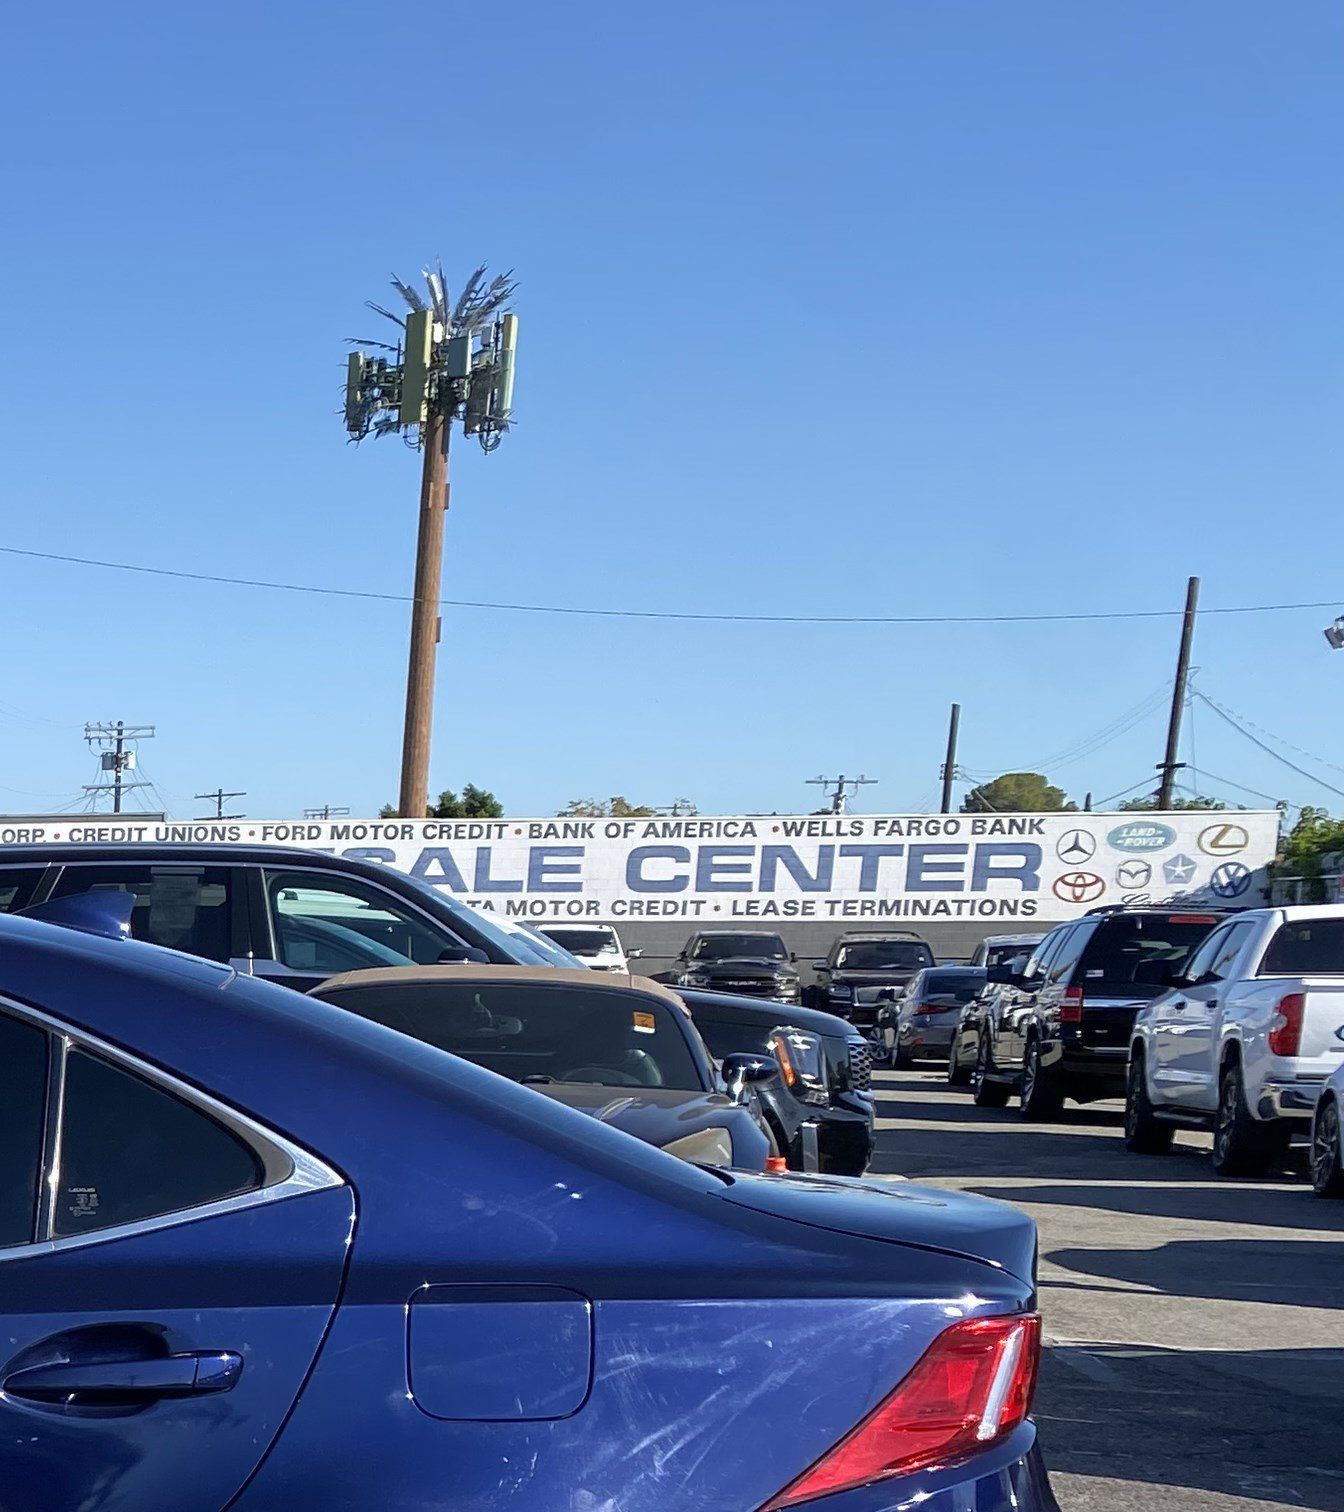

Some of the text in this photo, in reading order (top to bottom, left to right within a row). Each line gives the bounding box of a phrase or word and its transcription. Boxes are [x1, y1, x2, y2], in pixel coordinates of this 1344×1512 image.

[69, 827, 147, 842] CREDIT
[156, 825, 241, 842] UNIONS
[262, 825, 322, 841] FORD
[330, 824, 414, 840] MOTOR
[422, 823, 508, 840] CREDIT
[528, 822, 596, 840] BANK
[604, 822, 636, 839] OF
[641, 821, 758, 838] AMERICA
[782, 820, 864, 838] WELLS
[873, 819, 961, 837] FARGO
[970, 818, 1047, 836] BANK
[625, 842, 1043, 893] CENTER
[505, 898, 601, 916] MOTOR
[612, 899, 707, 916] CREDIT
[731, 898, 816, 917] LEASE
[825, 898, 1038, 917] TERMINATIONS
